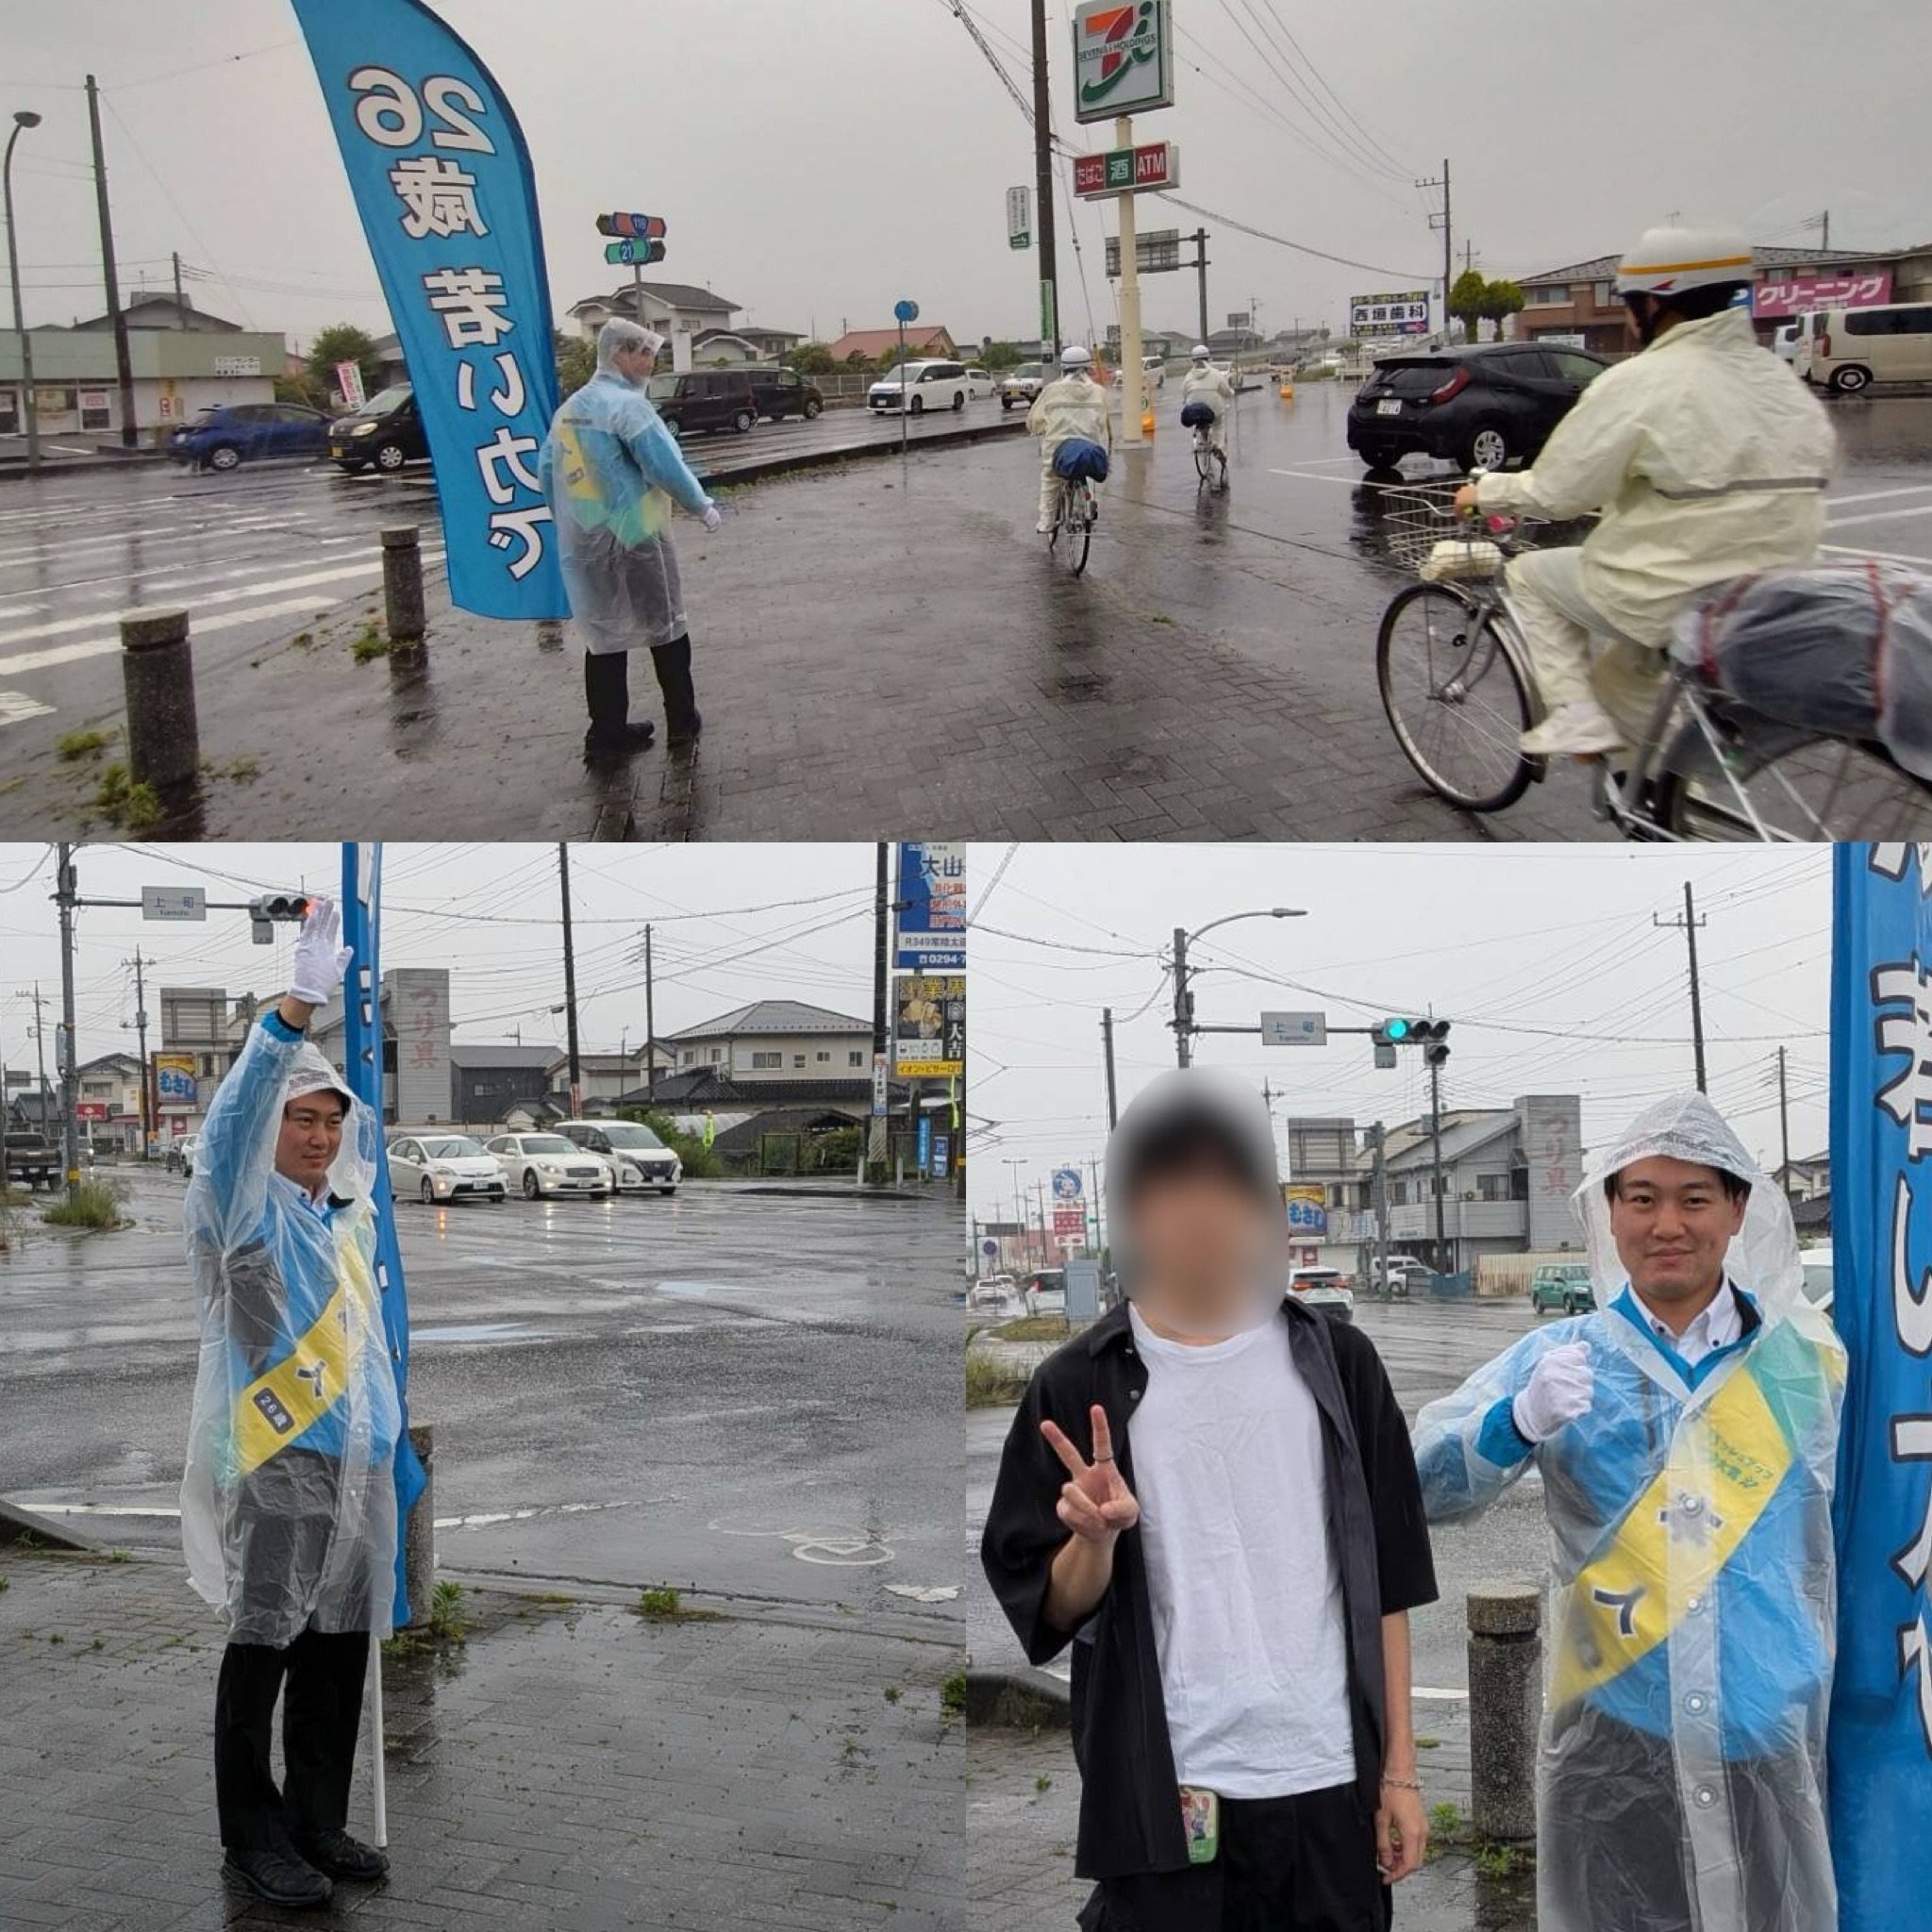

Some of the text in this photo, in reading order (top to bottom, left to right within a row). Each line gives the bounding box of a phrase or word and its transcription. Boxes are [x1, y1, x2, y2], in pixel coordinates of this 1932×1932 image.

[1077, 152, 1165, 186] たばこ 酒 ATM
[622, 244, 633, 260] 21
[1757, 275, 1885, 307] クリーニング
[1355, 304, 1424, 322] 西垣歯科
[922, 855, 966, 877] 大山
[408, 987, 438, 1069] つり具
[947, 1023, 962, 1059] 大吉
[159, 1071, 196, 1097] むさし
[1540, 1114, 1570, 1196] つり具
[1289, 1202, 1327, 1229] むさし
